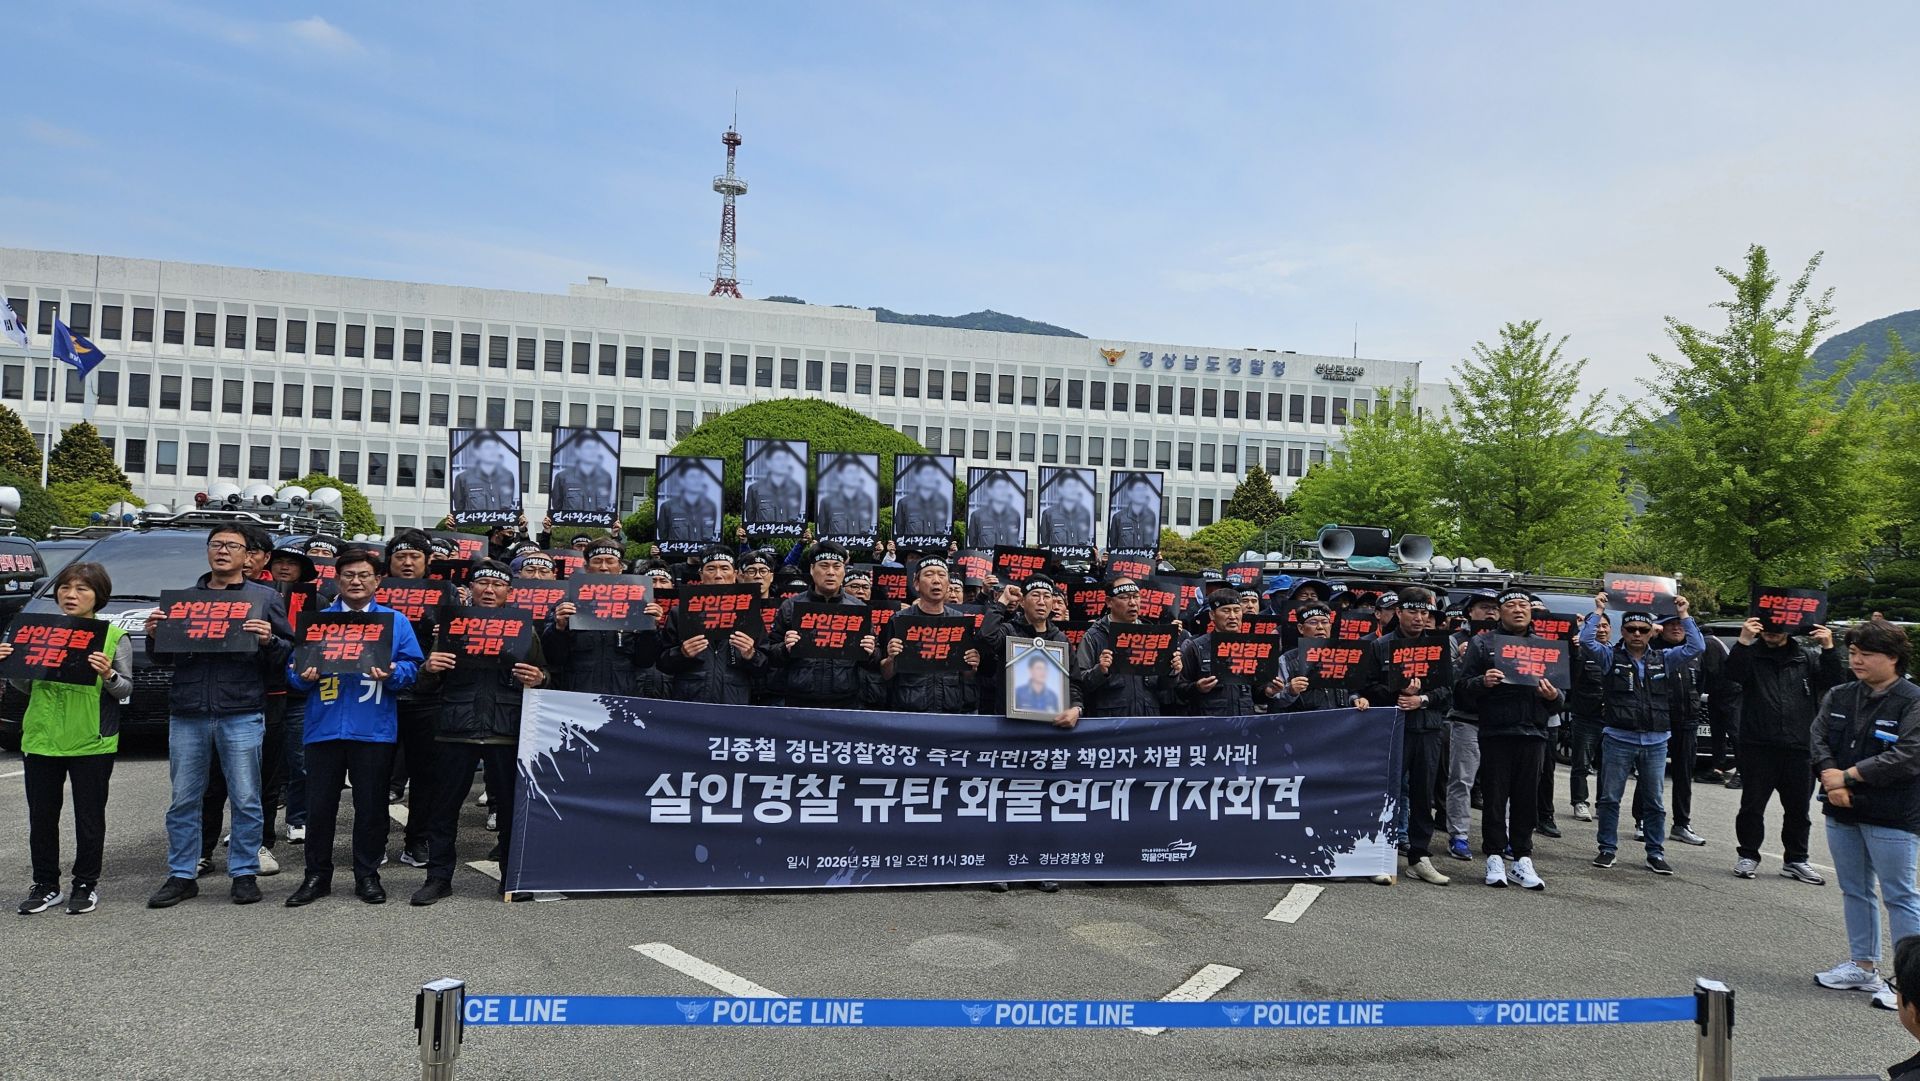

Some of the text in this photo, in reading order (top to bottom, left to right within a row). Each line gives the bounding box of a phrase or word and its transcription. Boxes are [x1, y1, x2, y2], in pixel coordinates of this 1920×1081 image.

[1140, 351, 1286, 377] 경상남도경찰청
[746, 523, 803, 535] 열사정신계승
[896, 535, 949, 547] 열사정신계승
[998, 553, 1046, 569] 살인경찰
[578, 584, 646, 601] 살인경찰
[1611, 580, 1669, 593] 살인경찰
[374, 588, 443, 605] 살인경찰
[687, 594, 753, 611] 살인경찰
[1138, 588, 1176, 606] 인경찰
[1625, 592, 1656, 604] 규탄
[1758, 594, 1820, 613] 살인경찰
[168, 602, 252, 619] 살인경찰
[594, 602, 630, 618] 규탄
[1770, 611, 1803, 626] 규탄
[449, 617, 524, 637] 살인경찰
[703, 612, 737, 629] 규탄
[800, 613, 864, 631] 살인경찰
[1532, 620, 1572, 633] 인경찰
[14, 625, 95, 649] 살인경찰
[186, 620, 230, 639] 규탄
[305, 623, 384, 641] 살인경찰
[906, 625, 966, 642] 살인경찰
[465, 637, 504, 655] 규탄
[815, 631, 847, 648] 규탄
[1116, 633, 1172, 649] 살인경찰
[25, 646, 68, 667] 규탄
[322, 643, 364, 660] 규탄
[919, 643, 951, 659] 규탄
[1128, 650, 1159, 665] 규탄
[1217, 642, 1272, 658] 살인경찰
[1306, 647, 1363, 664] 살인경찰
[1393, 645, 1443, 663] 살인경찰
[1502, 644, 1560, 663] 살인경찰
[1229, 659, 1258, 674] 규탄
[1319, 664, 1348, 679] 규탄
[1402, 663, 1430, 679] 규탄
[1516, 661, 1547, 677] 규탄
[708, 736, 776, 763] 김종철
[785, 738, 920, 766] 경남경찰청장
[926, 748, 971, 769] 즉각
[1077, 746, 1137, 770] 책임자
[1143, 746, 1181, 768] 처벌
[1189, 745, 1206, 768] 및
[1213, 744, 1258, 766] 사과!
[645, 772, 1305, 824] 살인경찰 규탄 화물연대 기자회견
[786, 851, 1104, 869] 일시 2026년 5월 1일 오전 11시 30분 장소 경남경찰청 앞
[509, 999, 568, 1022] LINE
[713, 1000, 864, 1024] POLICE LINE
[995, 1003, 1135, 1026] POLICE LINE
[1253, 1003, 1384, 1026] POLICE LINE
[1496, 1001, 1620, 1024] POLICE LINE
